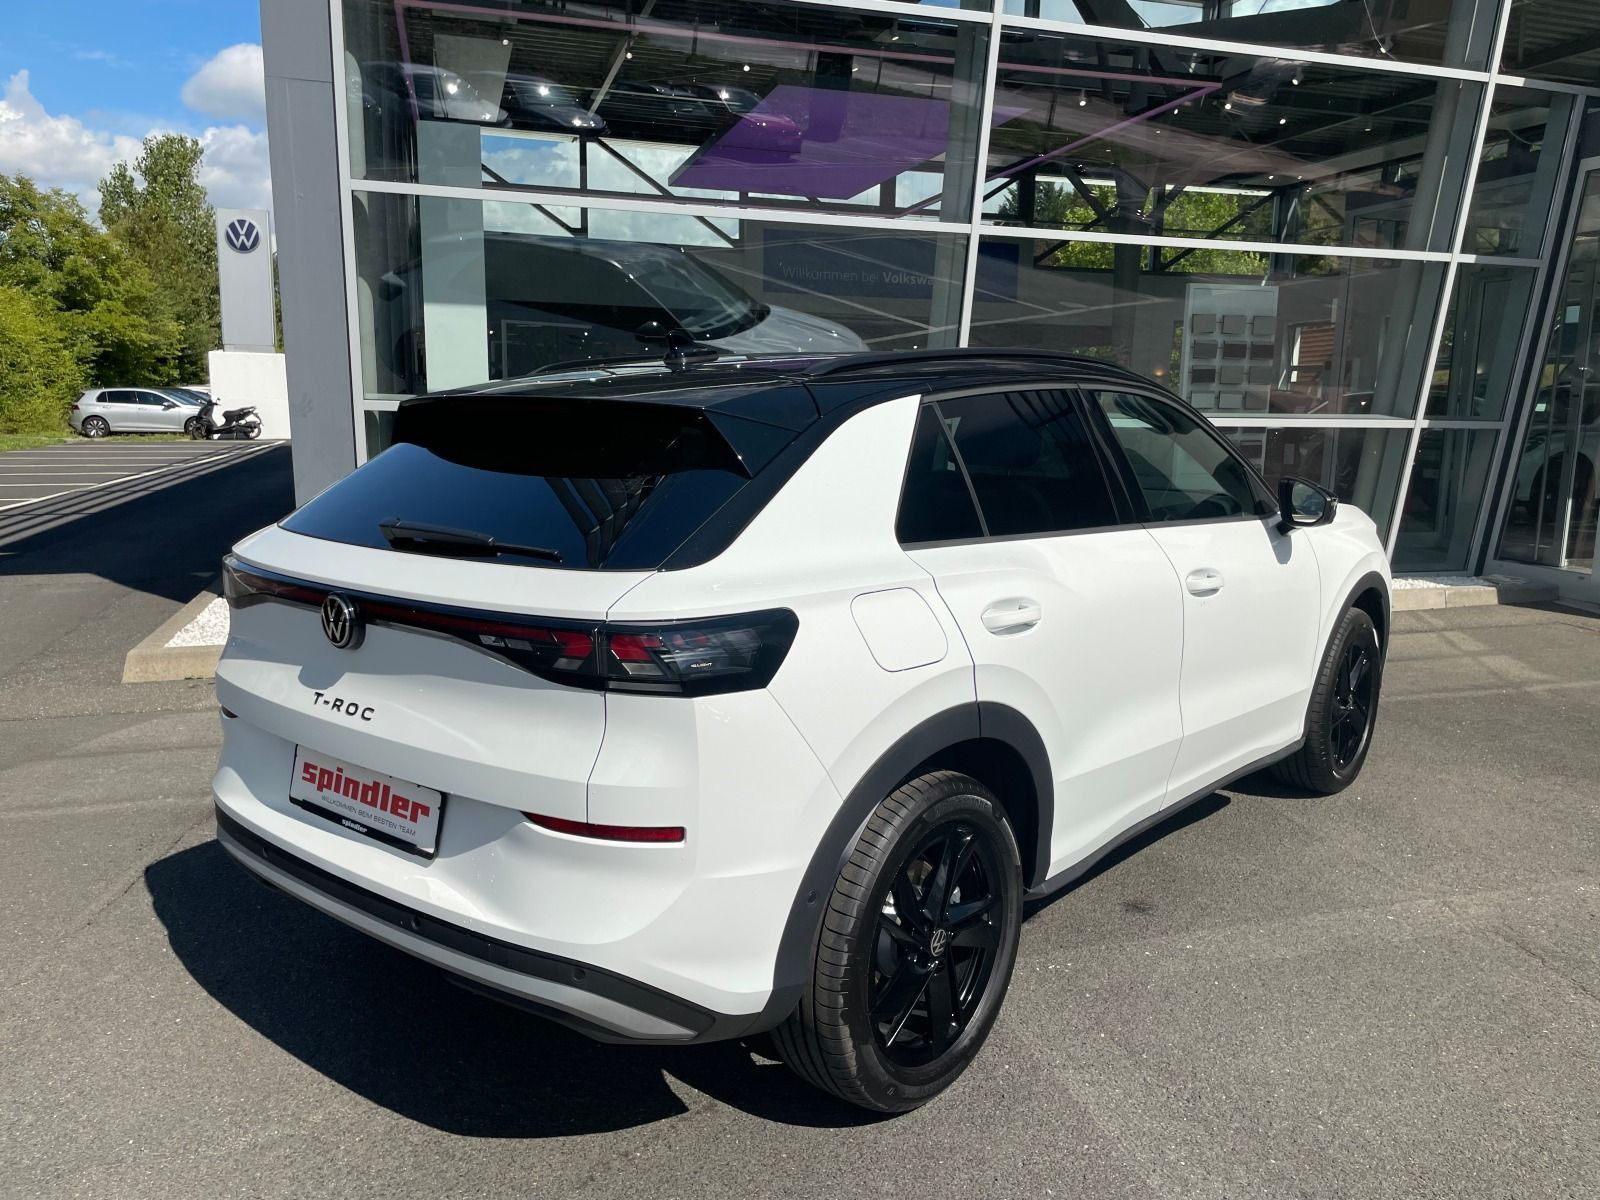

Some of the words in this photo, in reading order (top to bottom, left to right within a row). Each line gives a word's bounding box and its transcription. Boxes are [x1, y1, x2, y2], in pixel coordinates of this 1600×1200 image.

[783, 265, 859, 281] Willkommen
[312, 691, 375, 722] T-ROC
[301, 761, 431, 824] spindler
[358, 809, 373, 819] BEIM
[373, 815, 398, 830] BESTEN
[399, 825, 417, 837] TEAM
